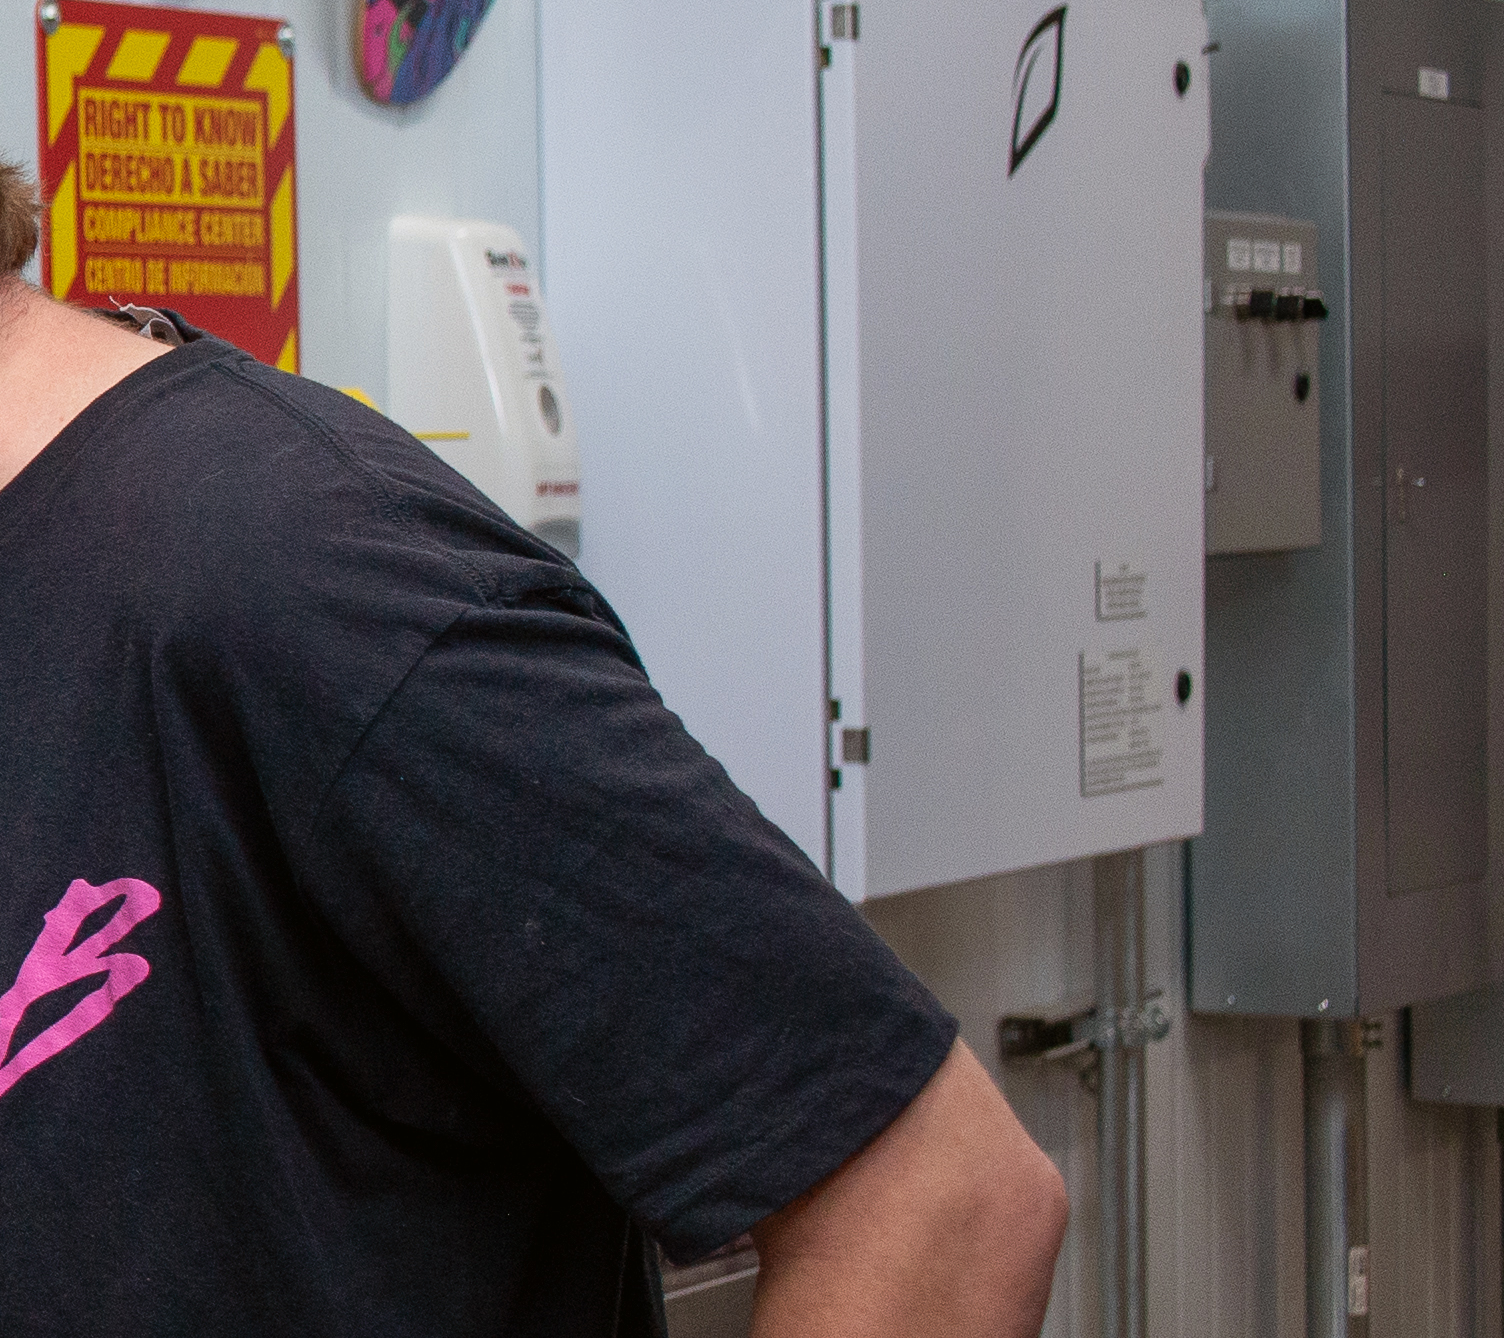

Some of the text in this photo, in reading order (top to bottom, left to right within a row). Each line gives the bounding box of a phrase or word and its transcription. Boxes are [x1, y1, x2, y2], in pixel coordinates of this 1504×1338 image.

[85, 99, 256, 146] RIGHT TO KNOW
[86, 153, 257, 198] DERECHO A SABER
